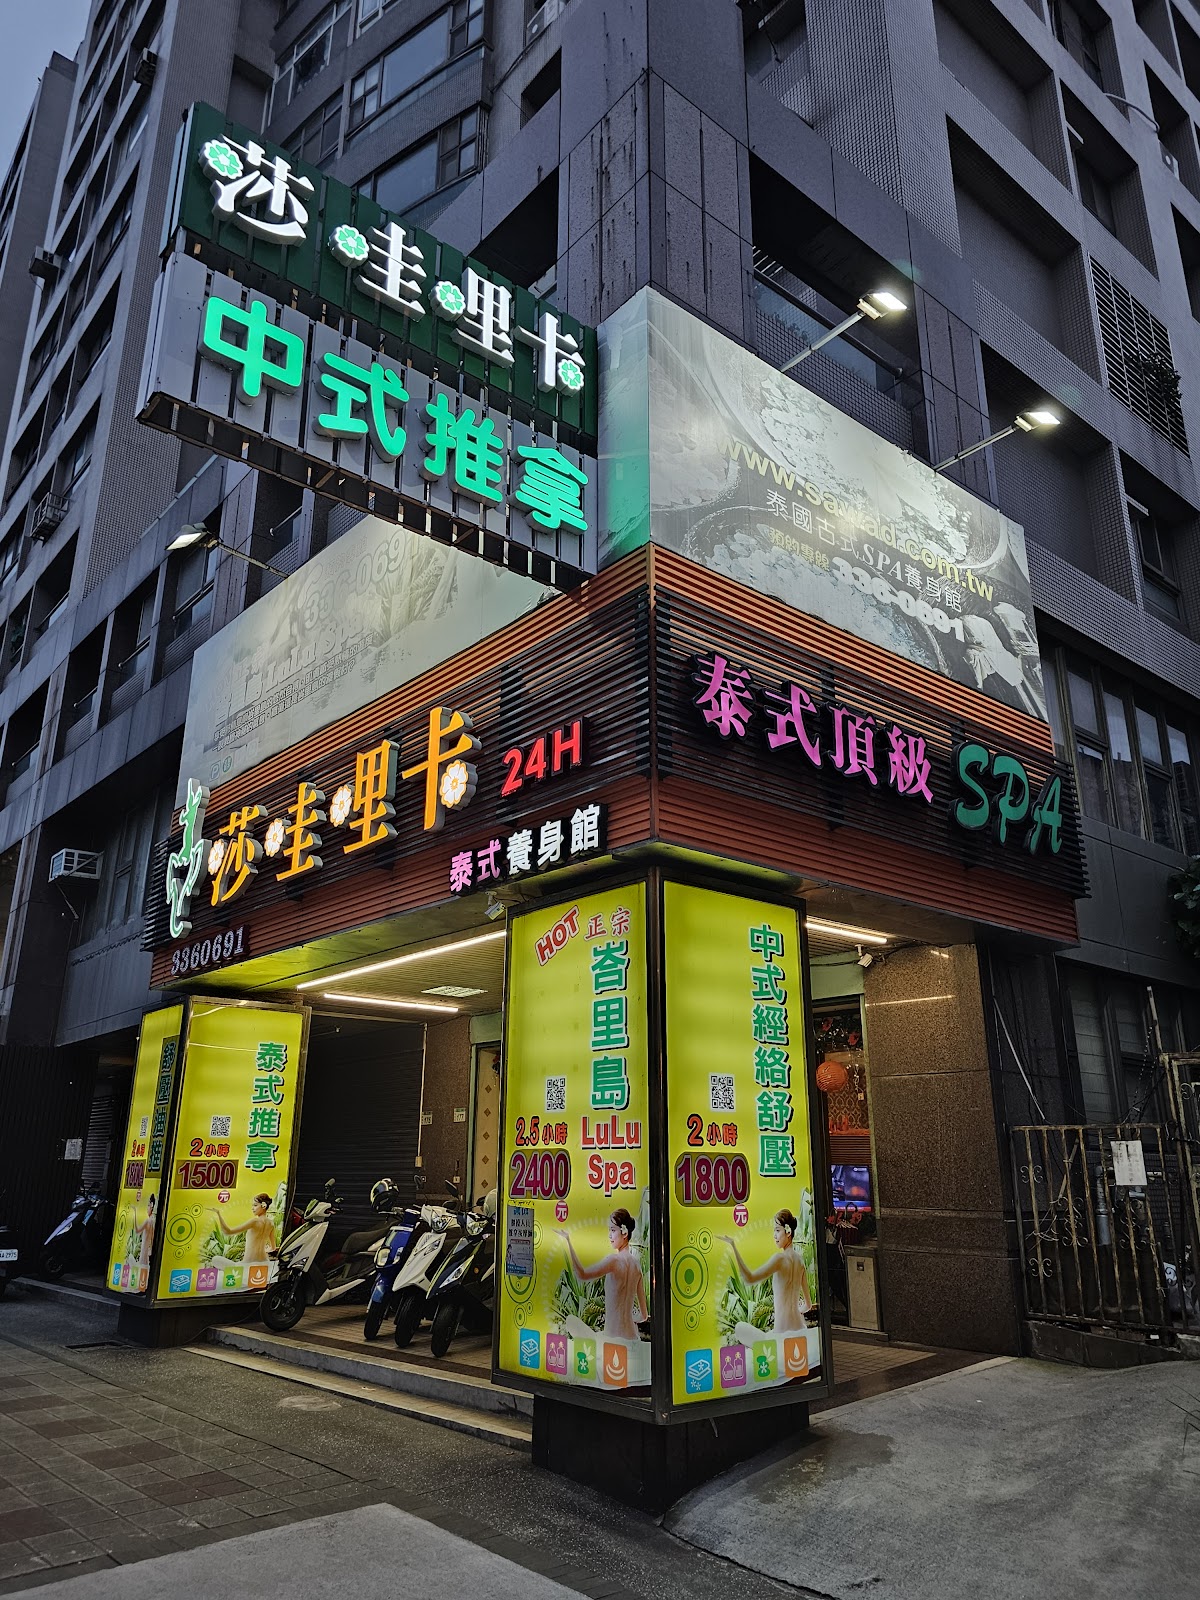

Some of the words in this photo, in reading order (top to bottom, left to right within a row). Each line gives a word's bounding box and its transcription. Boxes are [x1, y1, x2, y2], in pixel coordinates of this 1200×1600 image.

[203, 297, 589, 533] 中式推拿
[501, 720, 582, 798] 24H
[695, 654, 934, 804] 泰式頂級
[955, 743, 1062, 854] SPA
[207, 706, 476, 908] 莎圭里卡
[450, 803, 601, 892] 泰式養身館
[170, 925, 245, 976] 3360691
[535, 905, 580, 966] HOT
[584, 907, 631, 941] 正宗
[590, 941, 631, 1111] 峇里島
[749, 924, 796, 1178] 中式經絡舒壓
[245, 1042, 288, 1172] 泰式推拿
[515, 1116, 568, 1147] 2.5小時
[581, 1115, 641, 1149] LuLu
[687, 1113, 738, 1147] 2小時
[190, 1138, 231, 1158] 2小時
[178, 1160, 236, 1189] 1500
[510, 1151, 571, 1199] 2400
[587, 1154, 637, 1197] Spa
[676, 1153, 750, 1205] 1800
[557, 1202, 568, 1220] 元
[735, 1205, 747, 1223] 元
